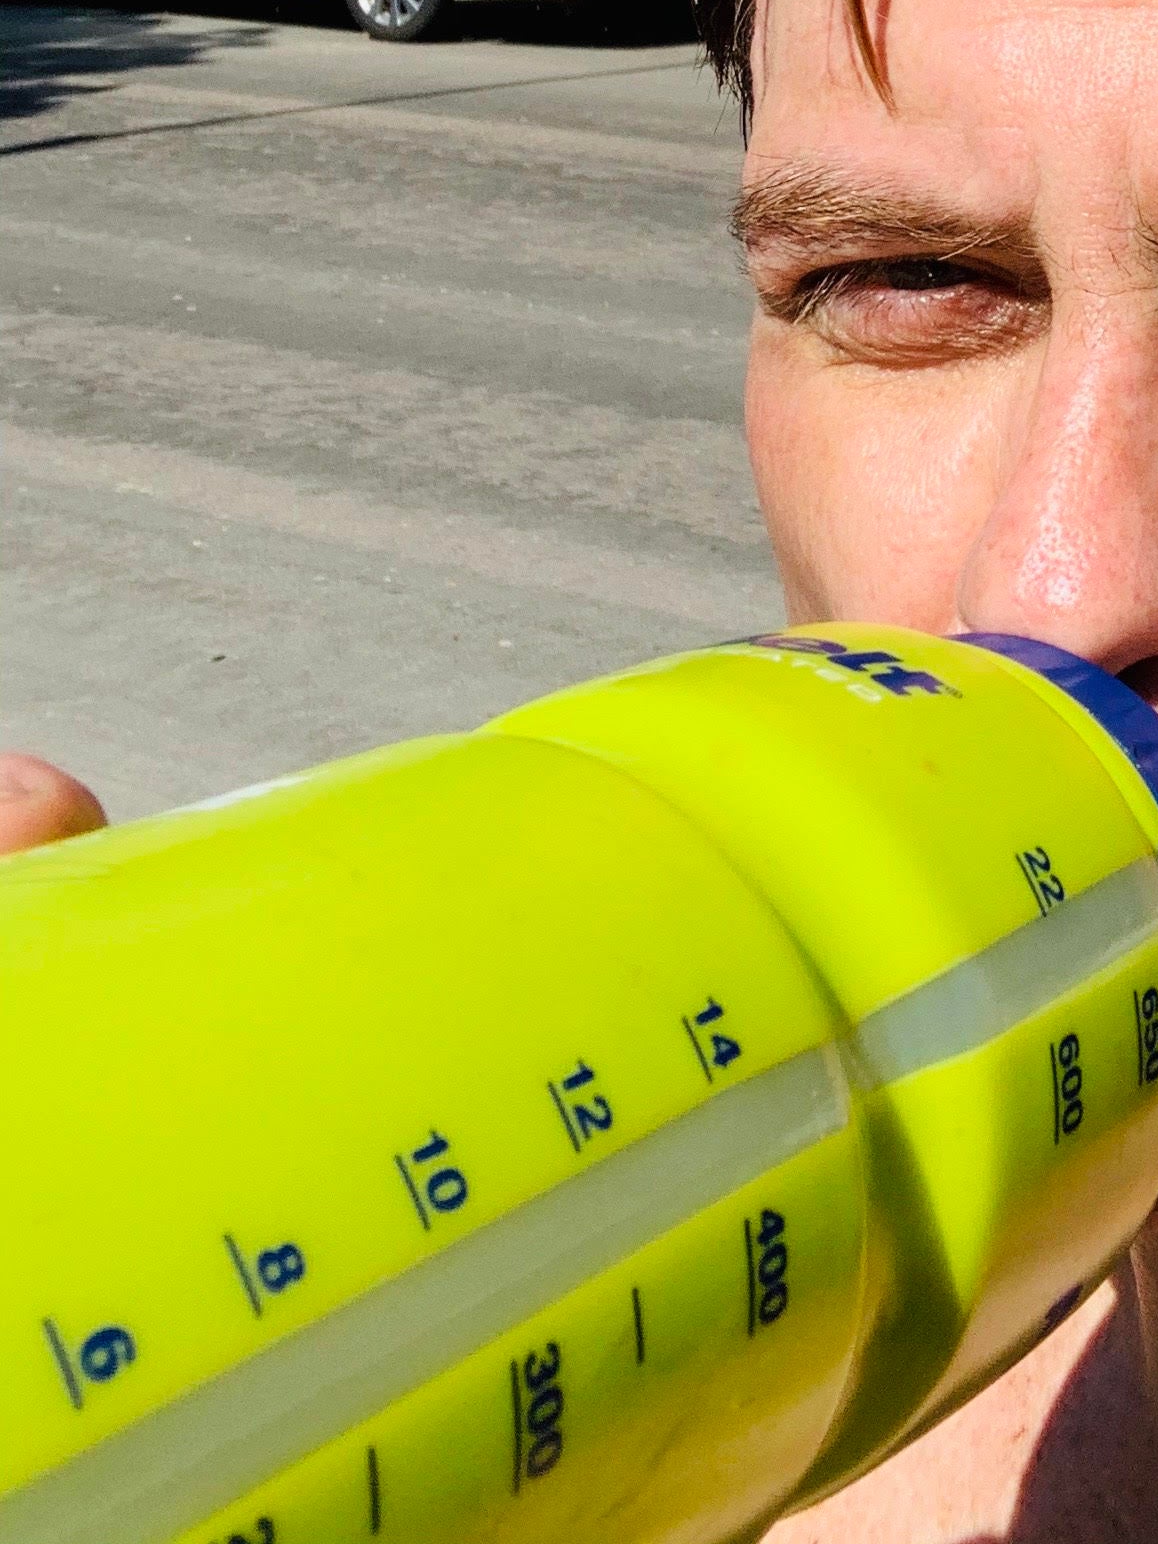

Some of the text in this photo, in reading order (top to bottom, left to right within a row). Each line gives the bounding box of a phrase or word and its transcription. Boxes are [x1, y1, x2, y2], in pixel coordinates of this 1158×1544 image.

[1022, 846, 1065, 909] 22
[694, 997, 742, 1070] 14
[562, 1060, 615, 1140] 12
[1055, 1031, 1085, 1137] 600
[412, 1130, 469, 1214] 10
[256, 1242, 307, 1294] 8
[757, 1208, 790, 1325] 400
[522, 1341, 566, 1481] 300
